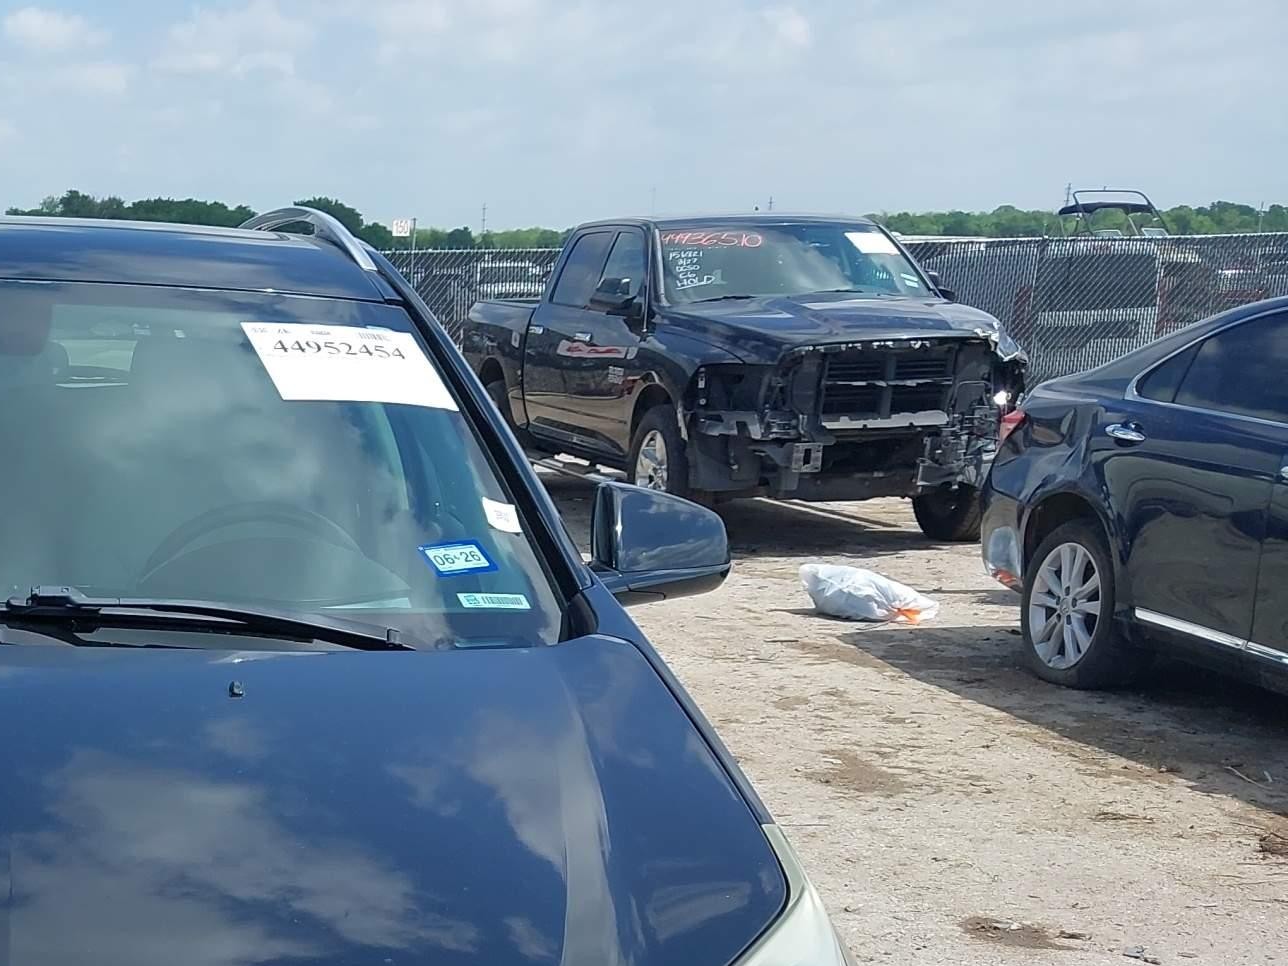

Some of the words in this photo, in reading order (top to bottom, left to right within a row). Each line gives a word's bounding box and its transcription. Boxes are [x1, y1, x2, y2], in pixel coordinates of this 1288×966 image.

[676, 275, 716, 288] HOLD
[273, 339, 406, 360] 44952454
[433, 553, 455, 566] 06
[460, 550, 481, 563] 26
